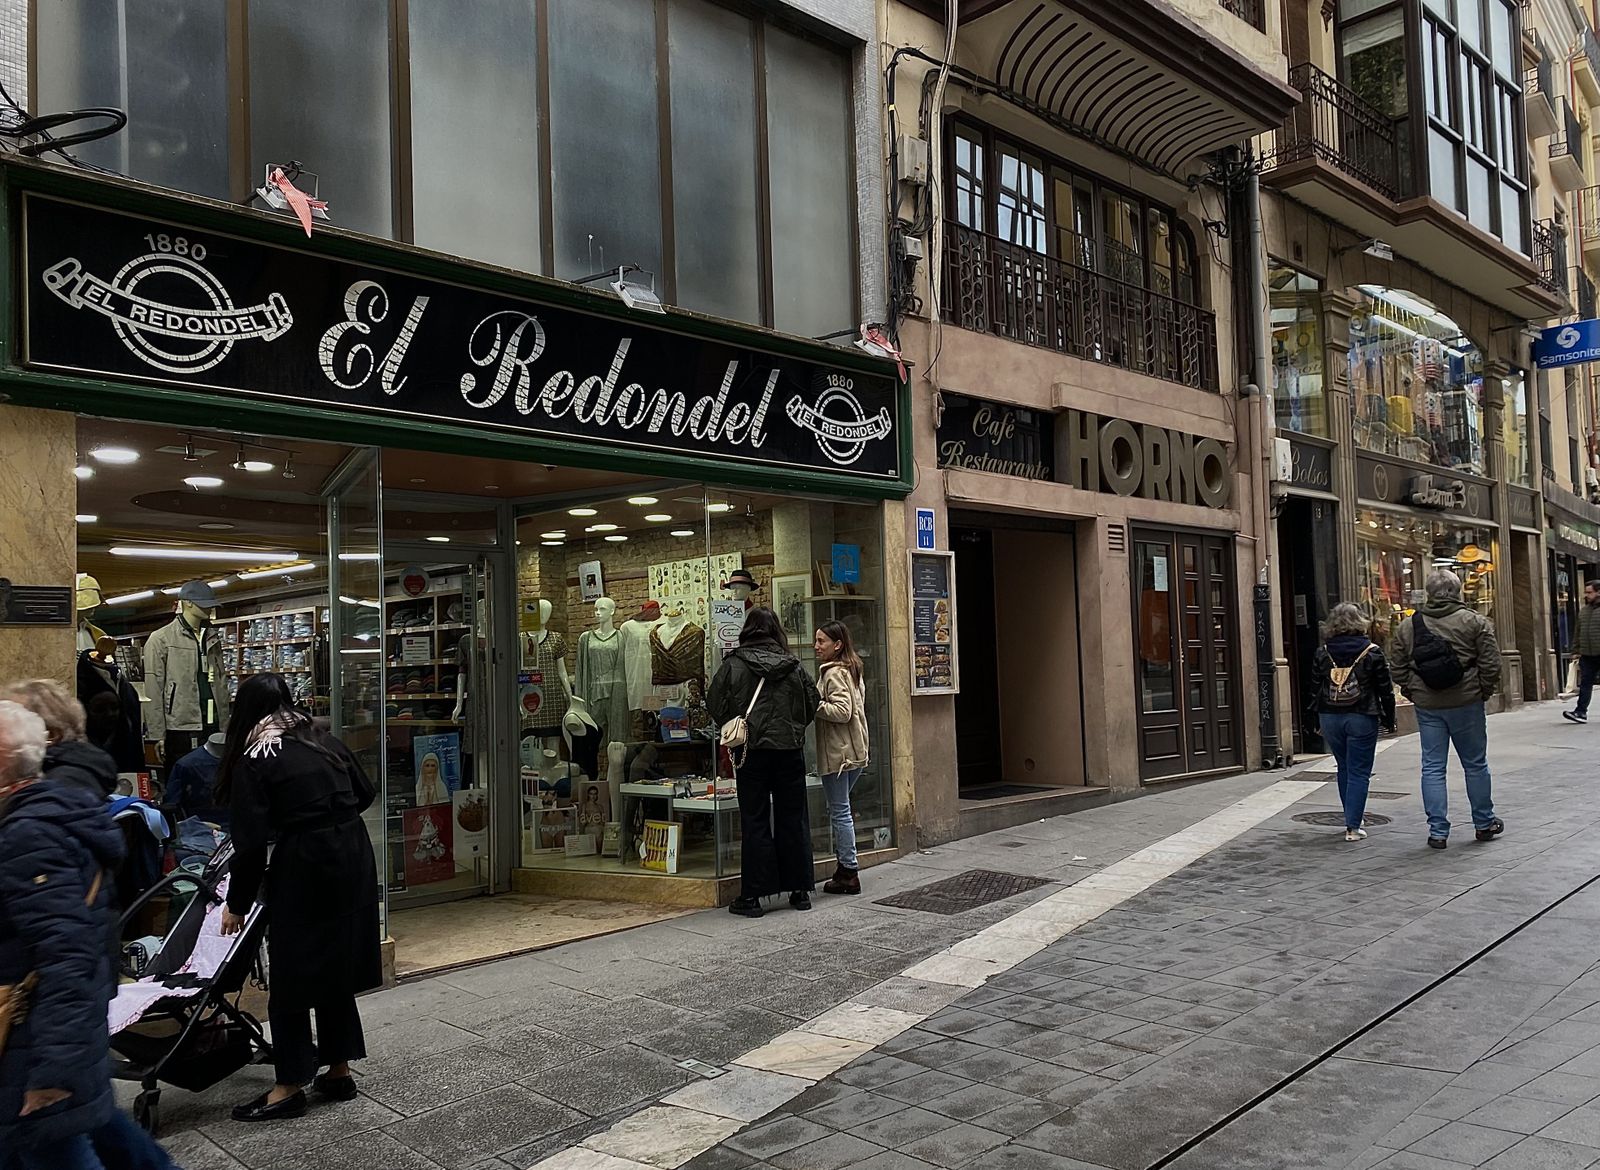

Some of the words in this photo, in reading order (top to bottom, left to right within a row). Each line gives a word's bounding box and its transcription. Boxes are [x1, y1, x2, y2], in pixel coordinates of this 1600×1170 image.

[144, 233, 207, 262] 1880
[86, 285, 116, 311] EL
[129, 303, 267, 335] REDONDEL
[318, 279, 430, 396] El
[460, 309, 781, 448] Redondel
[1539, 347, 1600, 366] Samsonite
[826, 373, 854, 391] 1880
[802, 411, 819, 426] EL
[821, 420, 881, 438] REDONDEL
[972, 407, 1017, 445] Café
[939, 440, 1050, 481] Restaurante
[1068, 408, 1232, 509] HORNO
[1291, 447, 1329, 487] Bolsos
[918, 516, 933, 532] RCB
